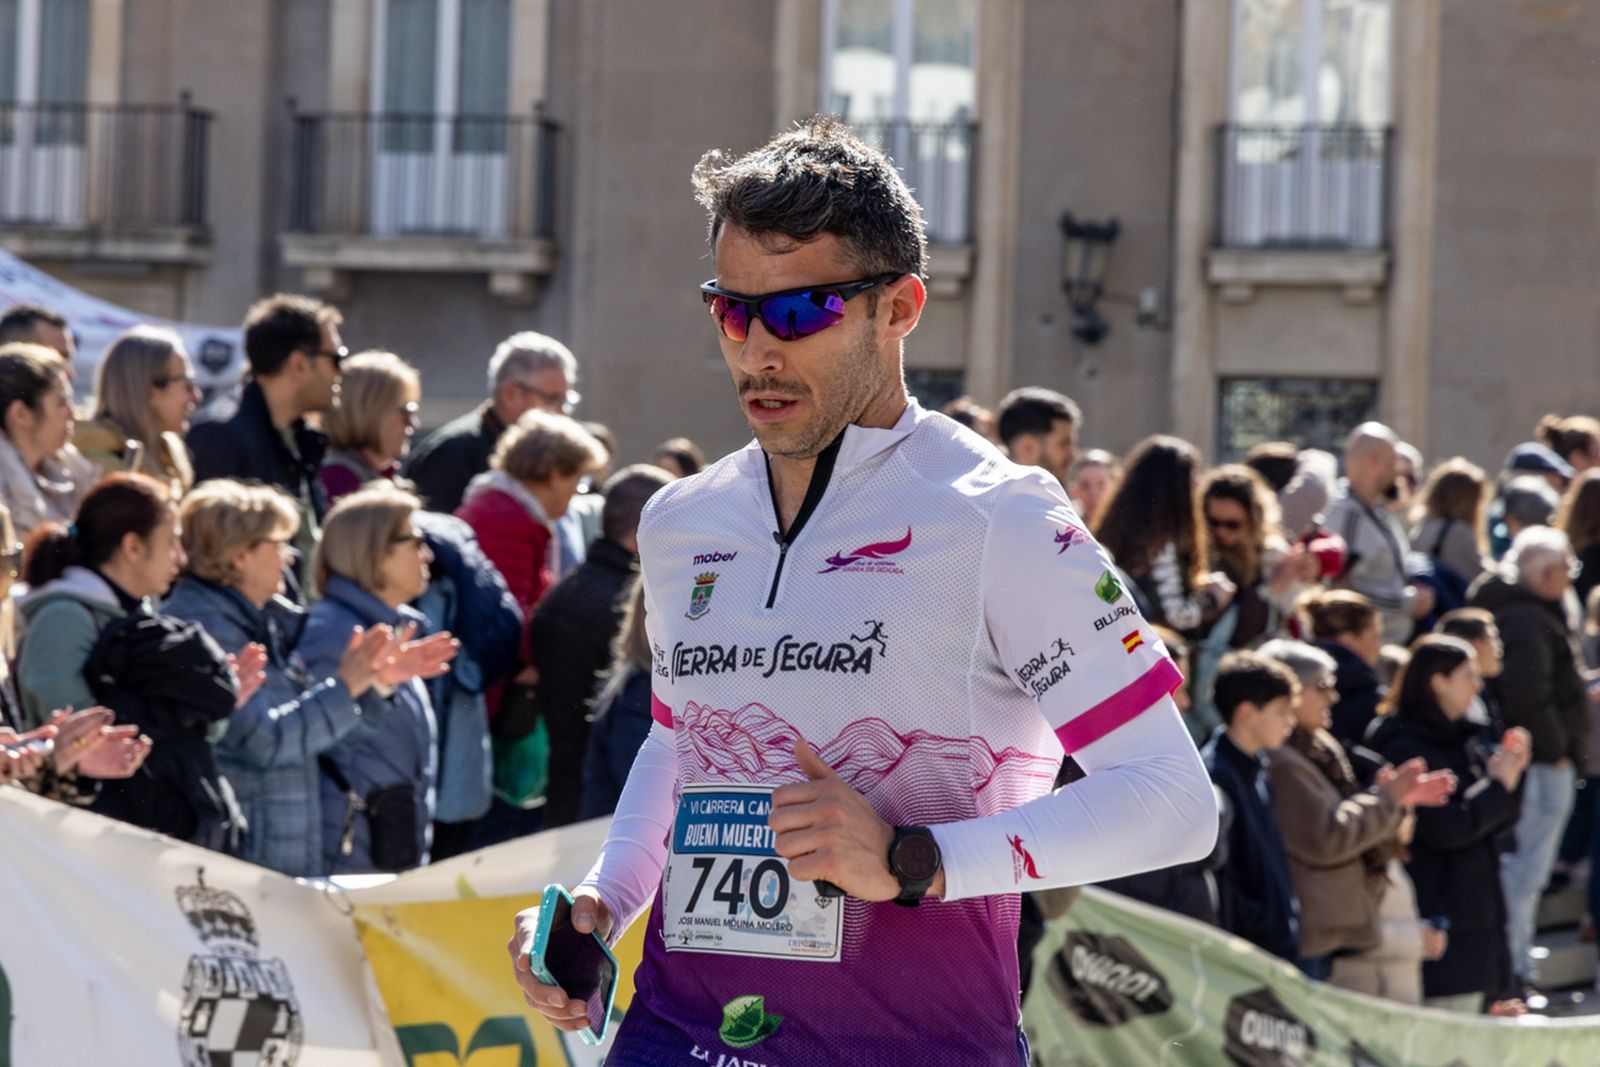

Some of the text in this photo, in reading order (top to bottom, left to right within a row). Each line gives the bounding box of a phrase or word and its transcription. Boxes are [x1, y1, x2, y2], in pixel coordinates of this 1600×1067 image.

[693, 551, 738, 565] mobel
[672, 641, 737, 685] SIERRA
[741, 647, 766, 668] DE
[763, 635, 873, 679] SEGURA
[1031, 660, 1072, 702] SEGURA
[690, 800, 699, 814] VI
[700, 799, 745, 815] CARRERA
[684, 823, 719, 847] BUENA
[684, 857, 790, 920] 740
[678, 916, 793, 932] JOSE MANUEL MOLINA MOLERO
